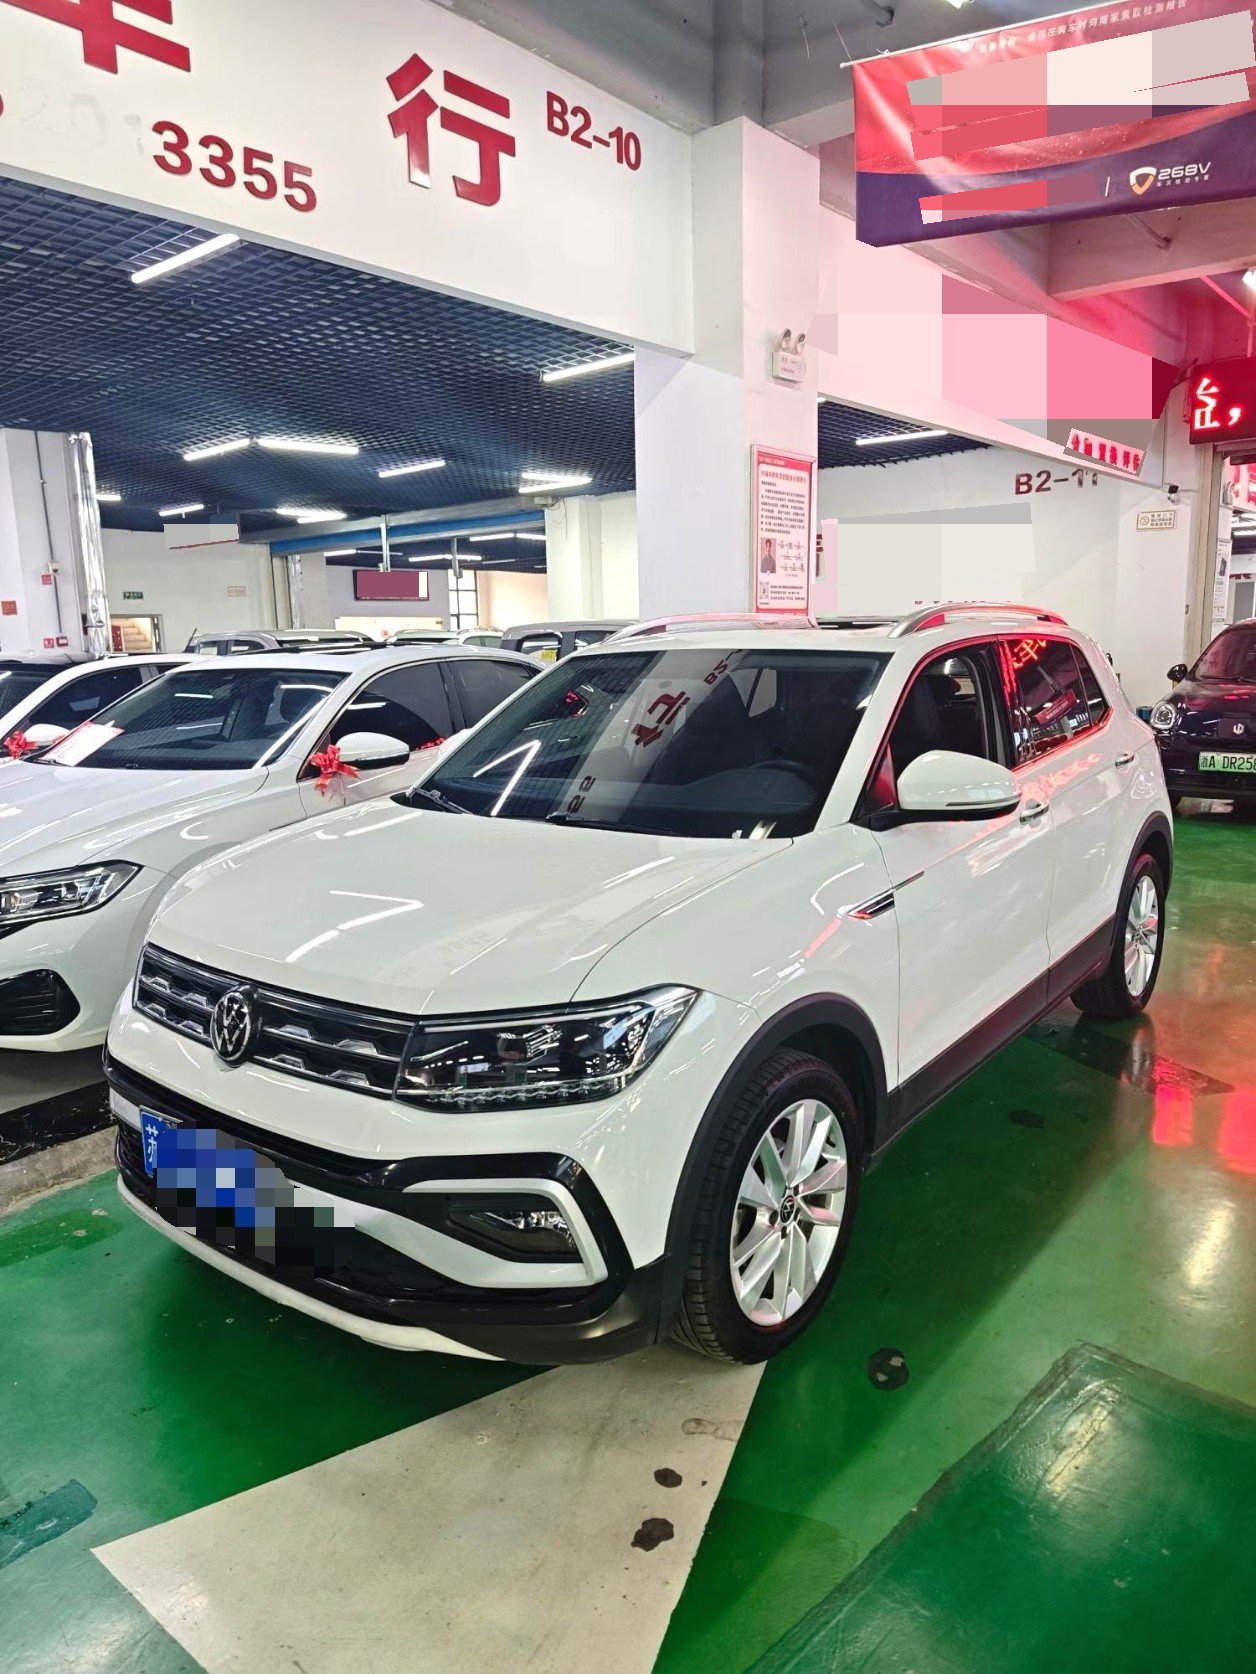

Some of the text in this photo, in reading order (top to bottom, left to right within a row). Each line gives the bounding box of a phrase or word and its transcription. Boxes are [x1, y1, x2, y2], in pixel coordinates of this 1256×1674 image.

[152, 120, 318, 213] 3355
[386, 53, 515, 207] 行
[546, 90, 642, 171] B2-10
[1158, 161, 1212, 181] 268V
